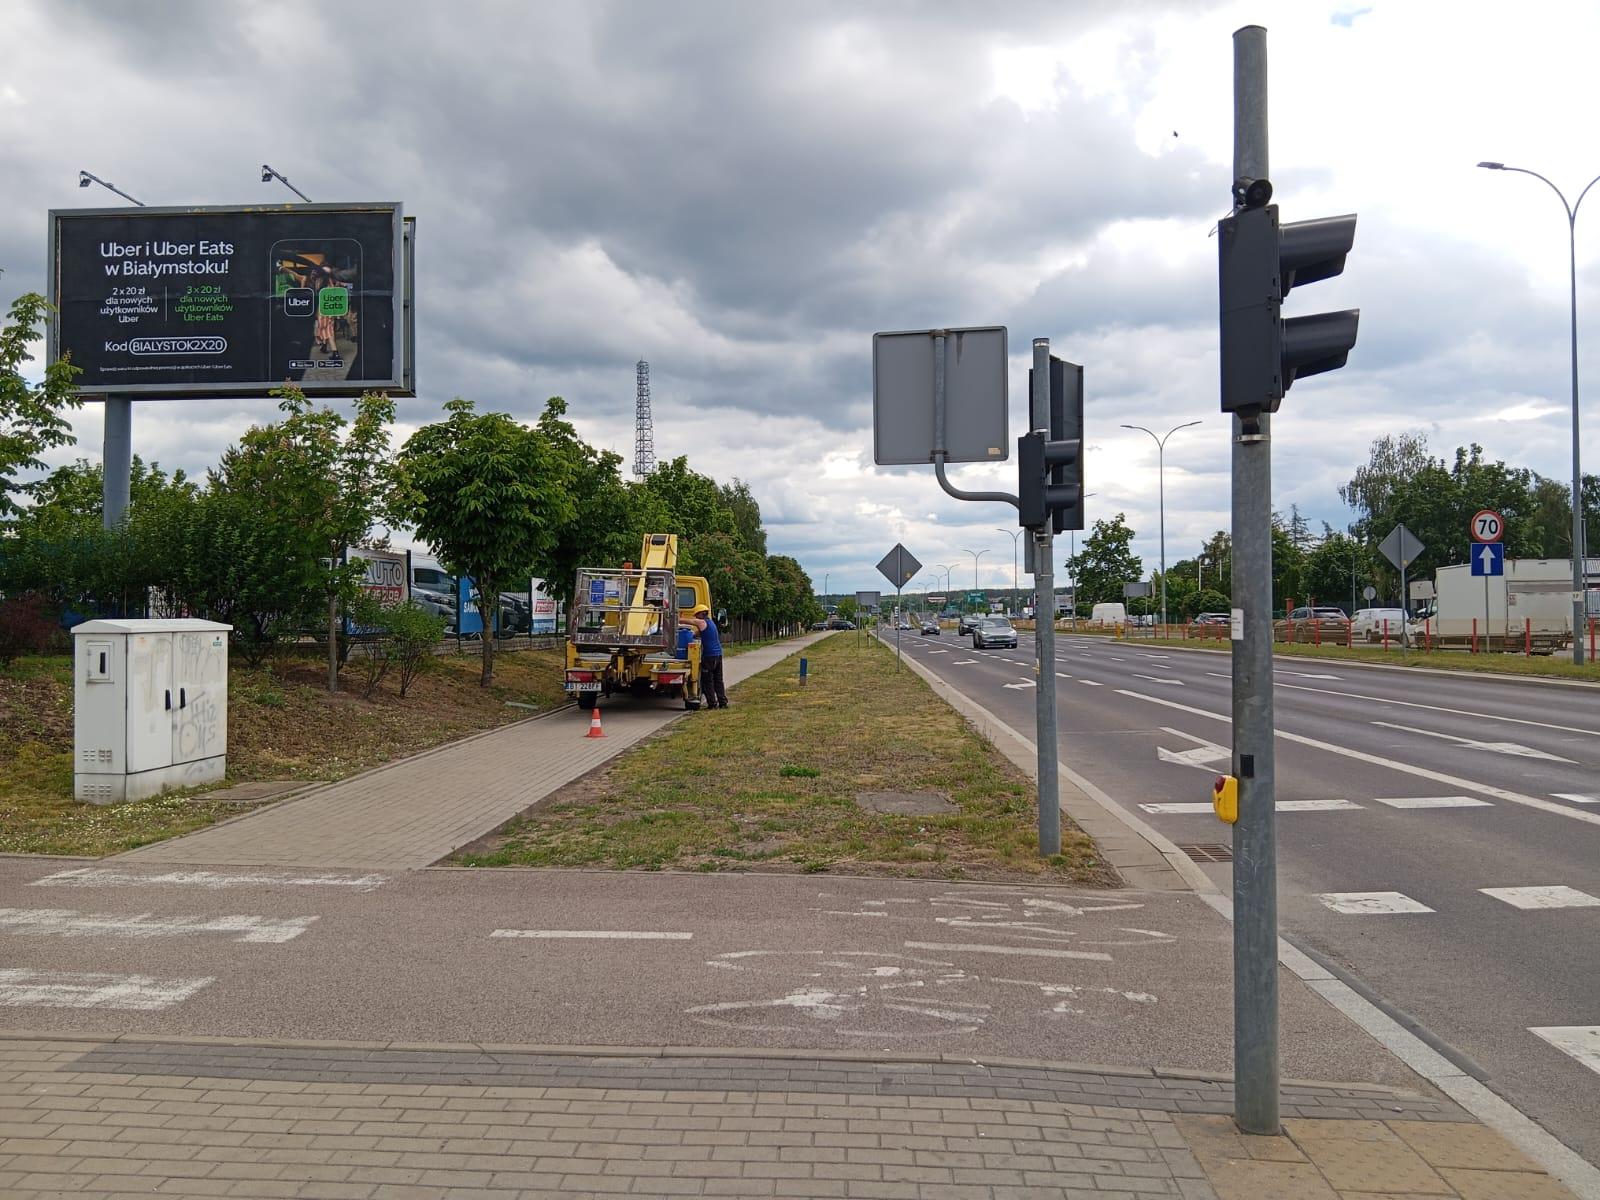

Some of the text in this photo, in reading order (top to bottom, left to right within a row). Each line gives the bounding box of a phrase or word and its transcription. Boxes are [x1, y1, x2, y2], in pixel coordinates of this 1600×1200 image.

[100, 240, 234, 257] Uber i Uber Eats
[105, 259, 229, 278] w Białymstoku!
[126, 287, 136, 295] 20
[187, 286, 192, 294] 3
[201, 286, 212, 294] 20
[105, 296, 153, 306] dla nowych
[180, 295, 228, 304] dla nowych
[288, 298, 310, 306] Uber
[100, 306, 158, 316] użytkowników
[118, 315, 139, 323] Uber
[206, 313, 224, 321] Eats
[105, 340, 224, 352] Kod BIALYSTOK2X20
[1478, 519, 1498, 535] 70
[360, 559, 404, 586] AUTO
